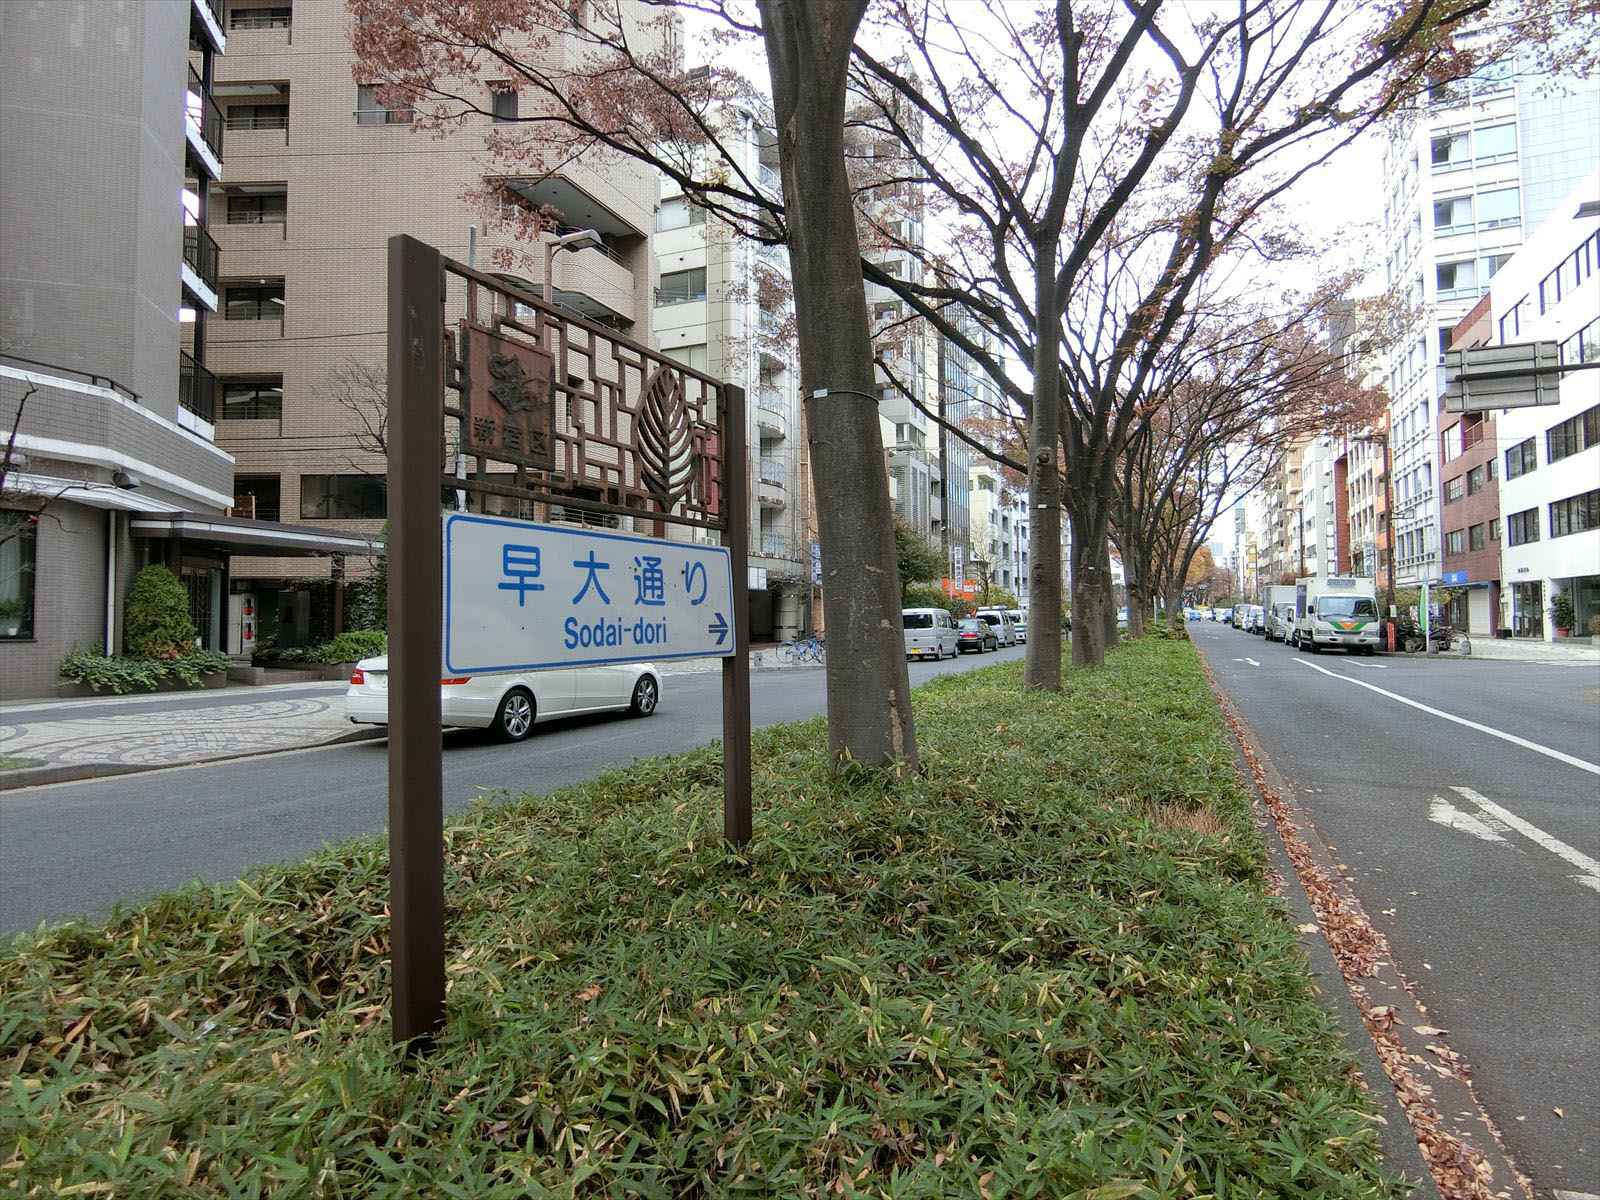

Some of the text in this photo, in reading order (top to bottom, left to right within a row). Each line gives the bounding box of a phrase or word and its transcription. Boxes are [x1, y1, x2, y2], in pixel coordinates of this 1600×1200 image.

[473, 416, 549, 455] 新宿区
[498, 543, 708, 606] 早大通り
[564, 616, 667, 649] Sodai-dori
